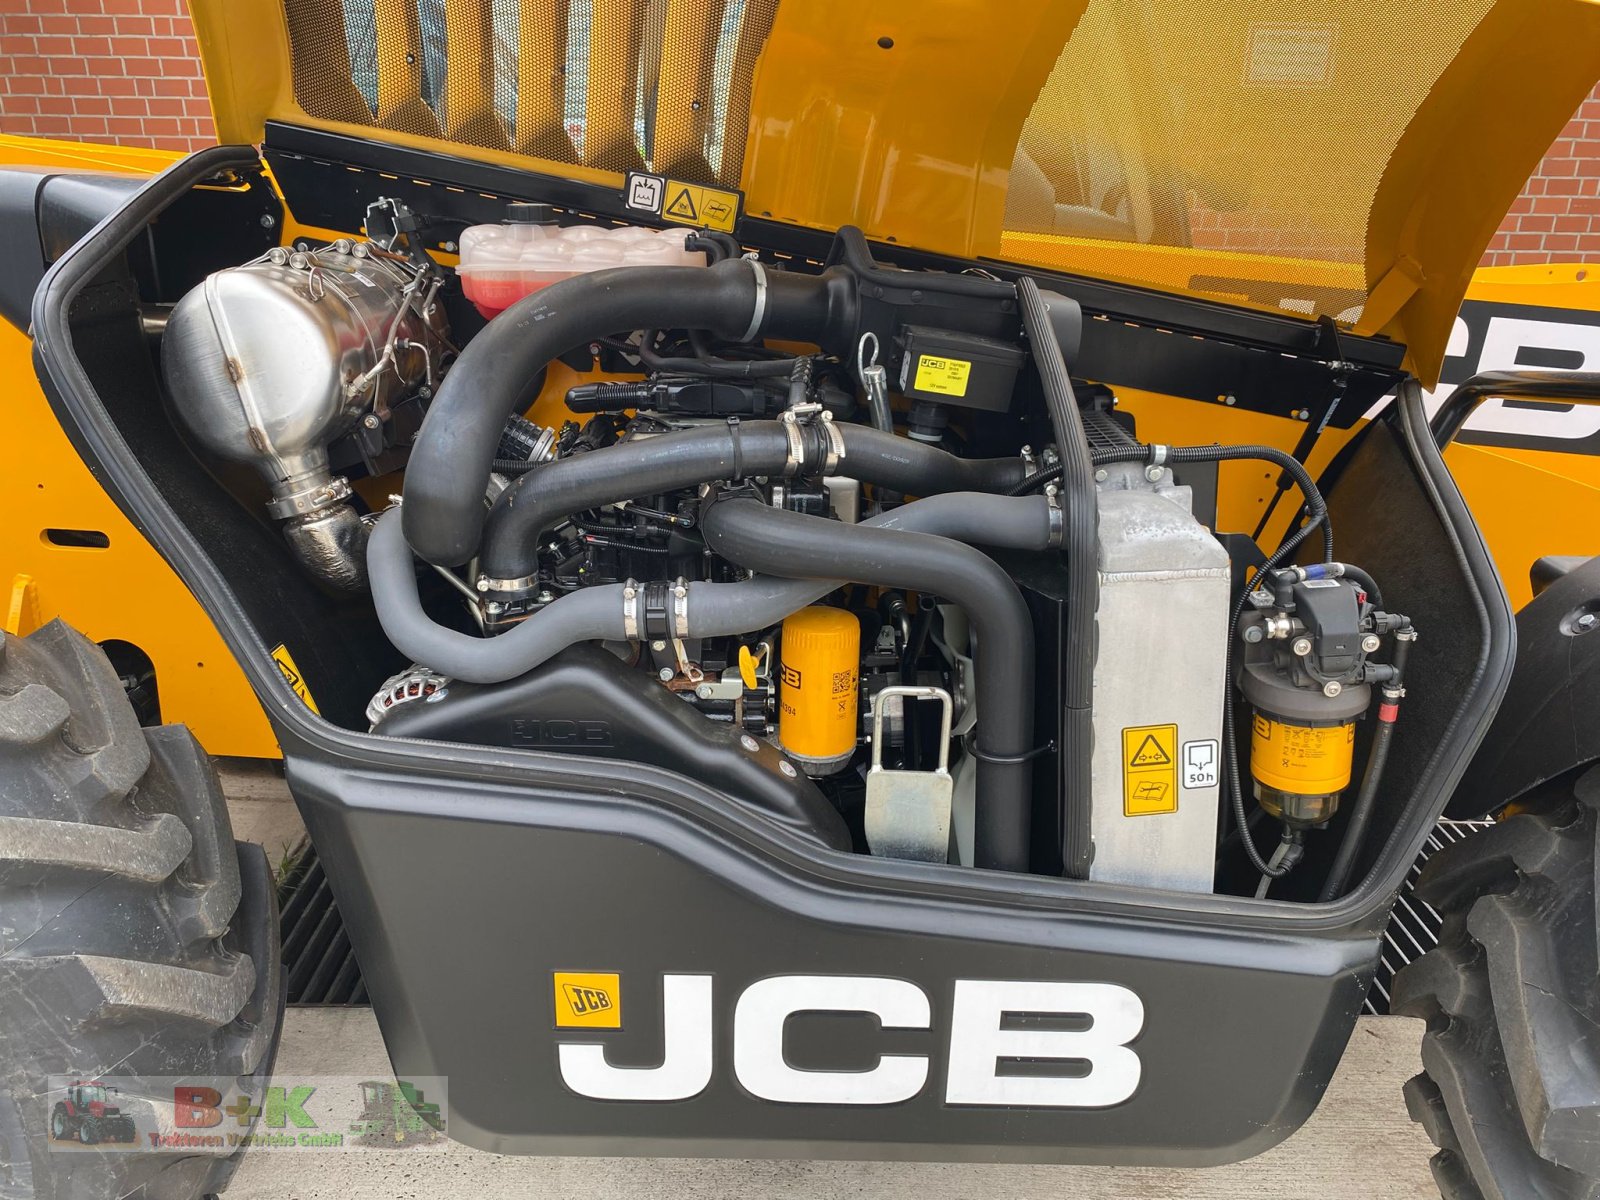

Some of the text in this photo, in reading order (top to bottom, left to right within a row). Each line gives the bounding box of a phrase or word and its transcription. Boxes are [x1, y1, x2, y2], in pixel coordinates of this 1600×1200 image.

[920, 359, 945, 369] JCB
[1190, 773, 1214, 783] 50 h
[572, 987, 610, 1013] JCB
[558, 974, 1144, 1106] JCB
